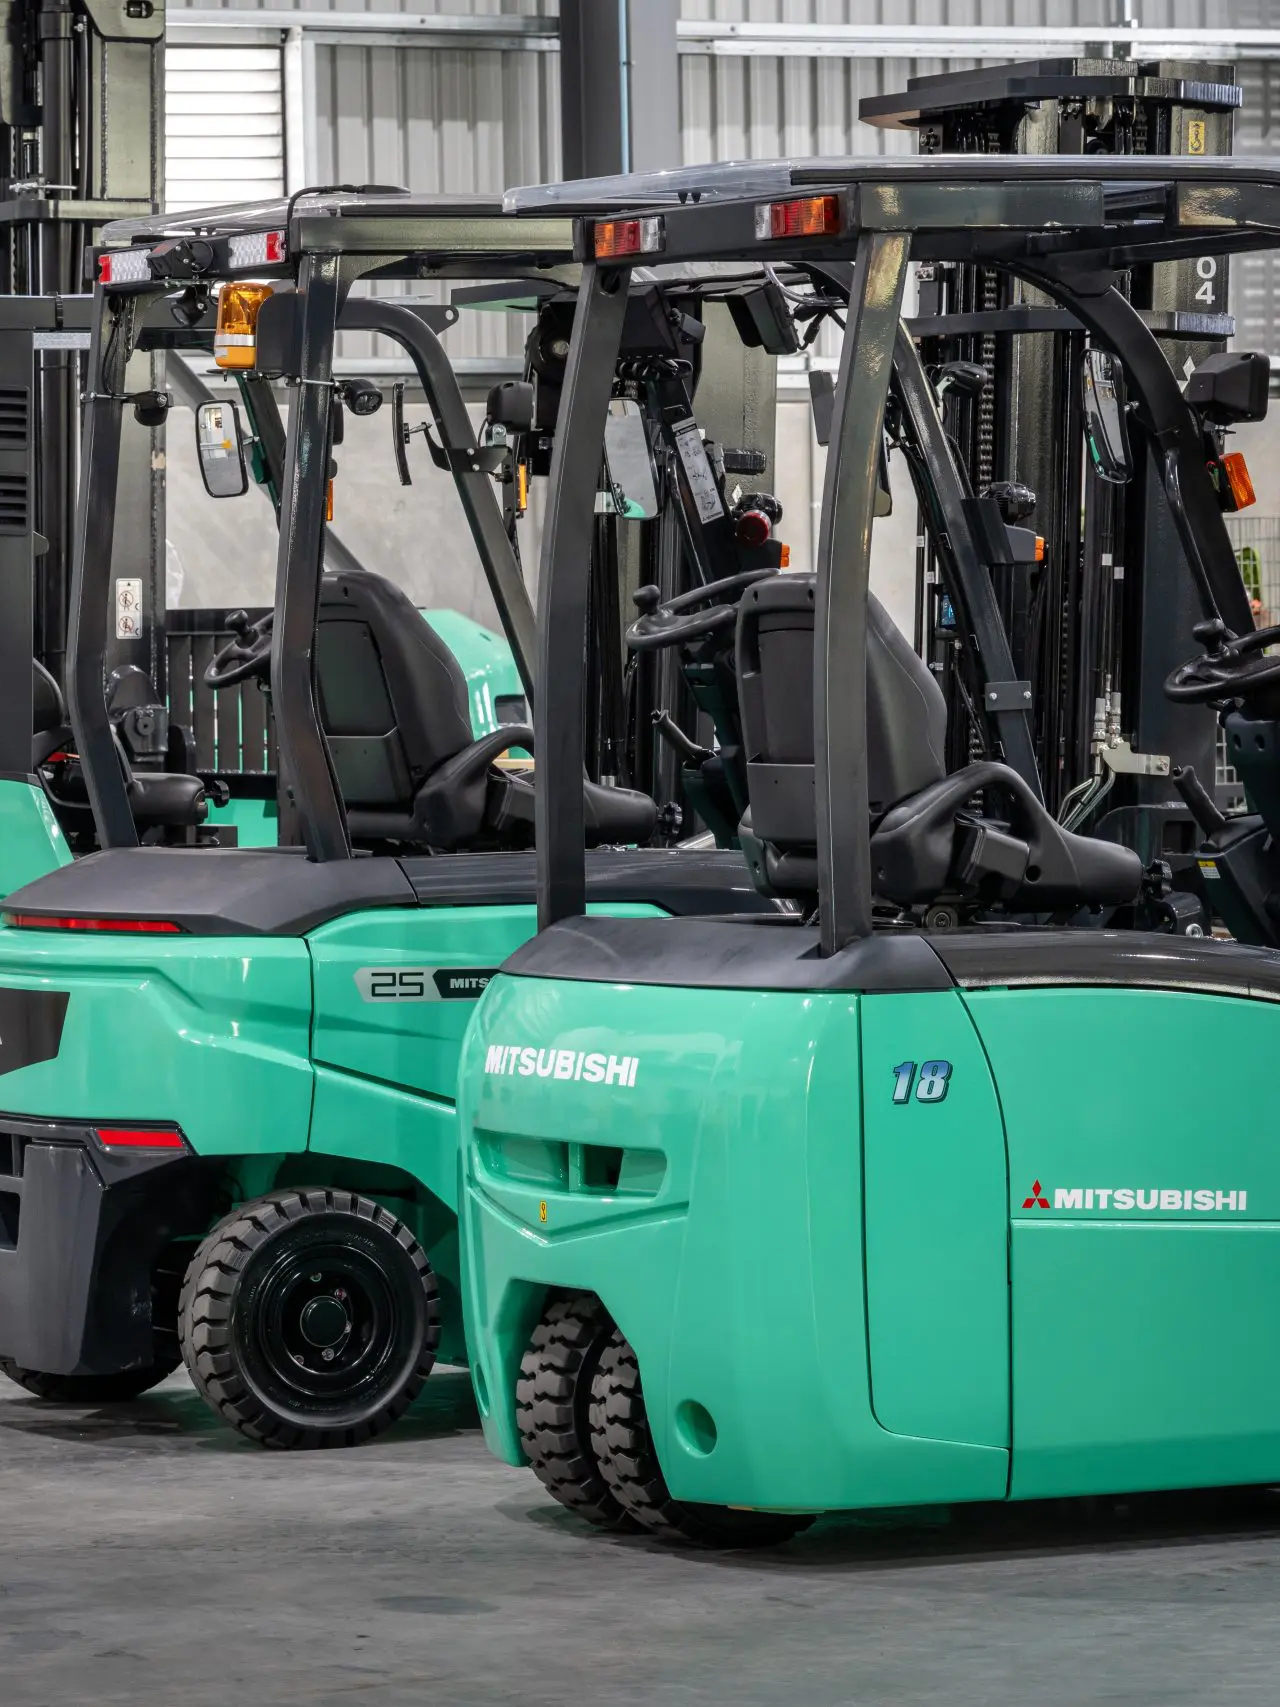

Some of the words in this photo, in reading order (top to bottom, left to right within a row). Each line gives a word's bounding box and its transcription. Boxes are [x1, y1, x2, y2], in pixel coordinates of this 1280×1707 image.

[371, 971, 424, 997] 25
[450, 977, 491, 989] MITS
[484, 1044, 640, 1088] MITSUBISHI
[892, 1059, 954, 1105] 18
[1053, 1188, 1248, 1211] MITSUBISHI
